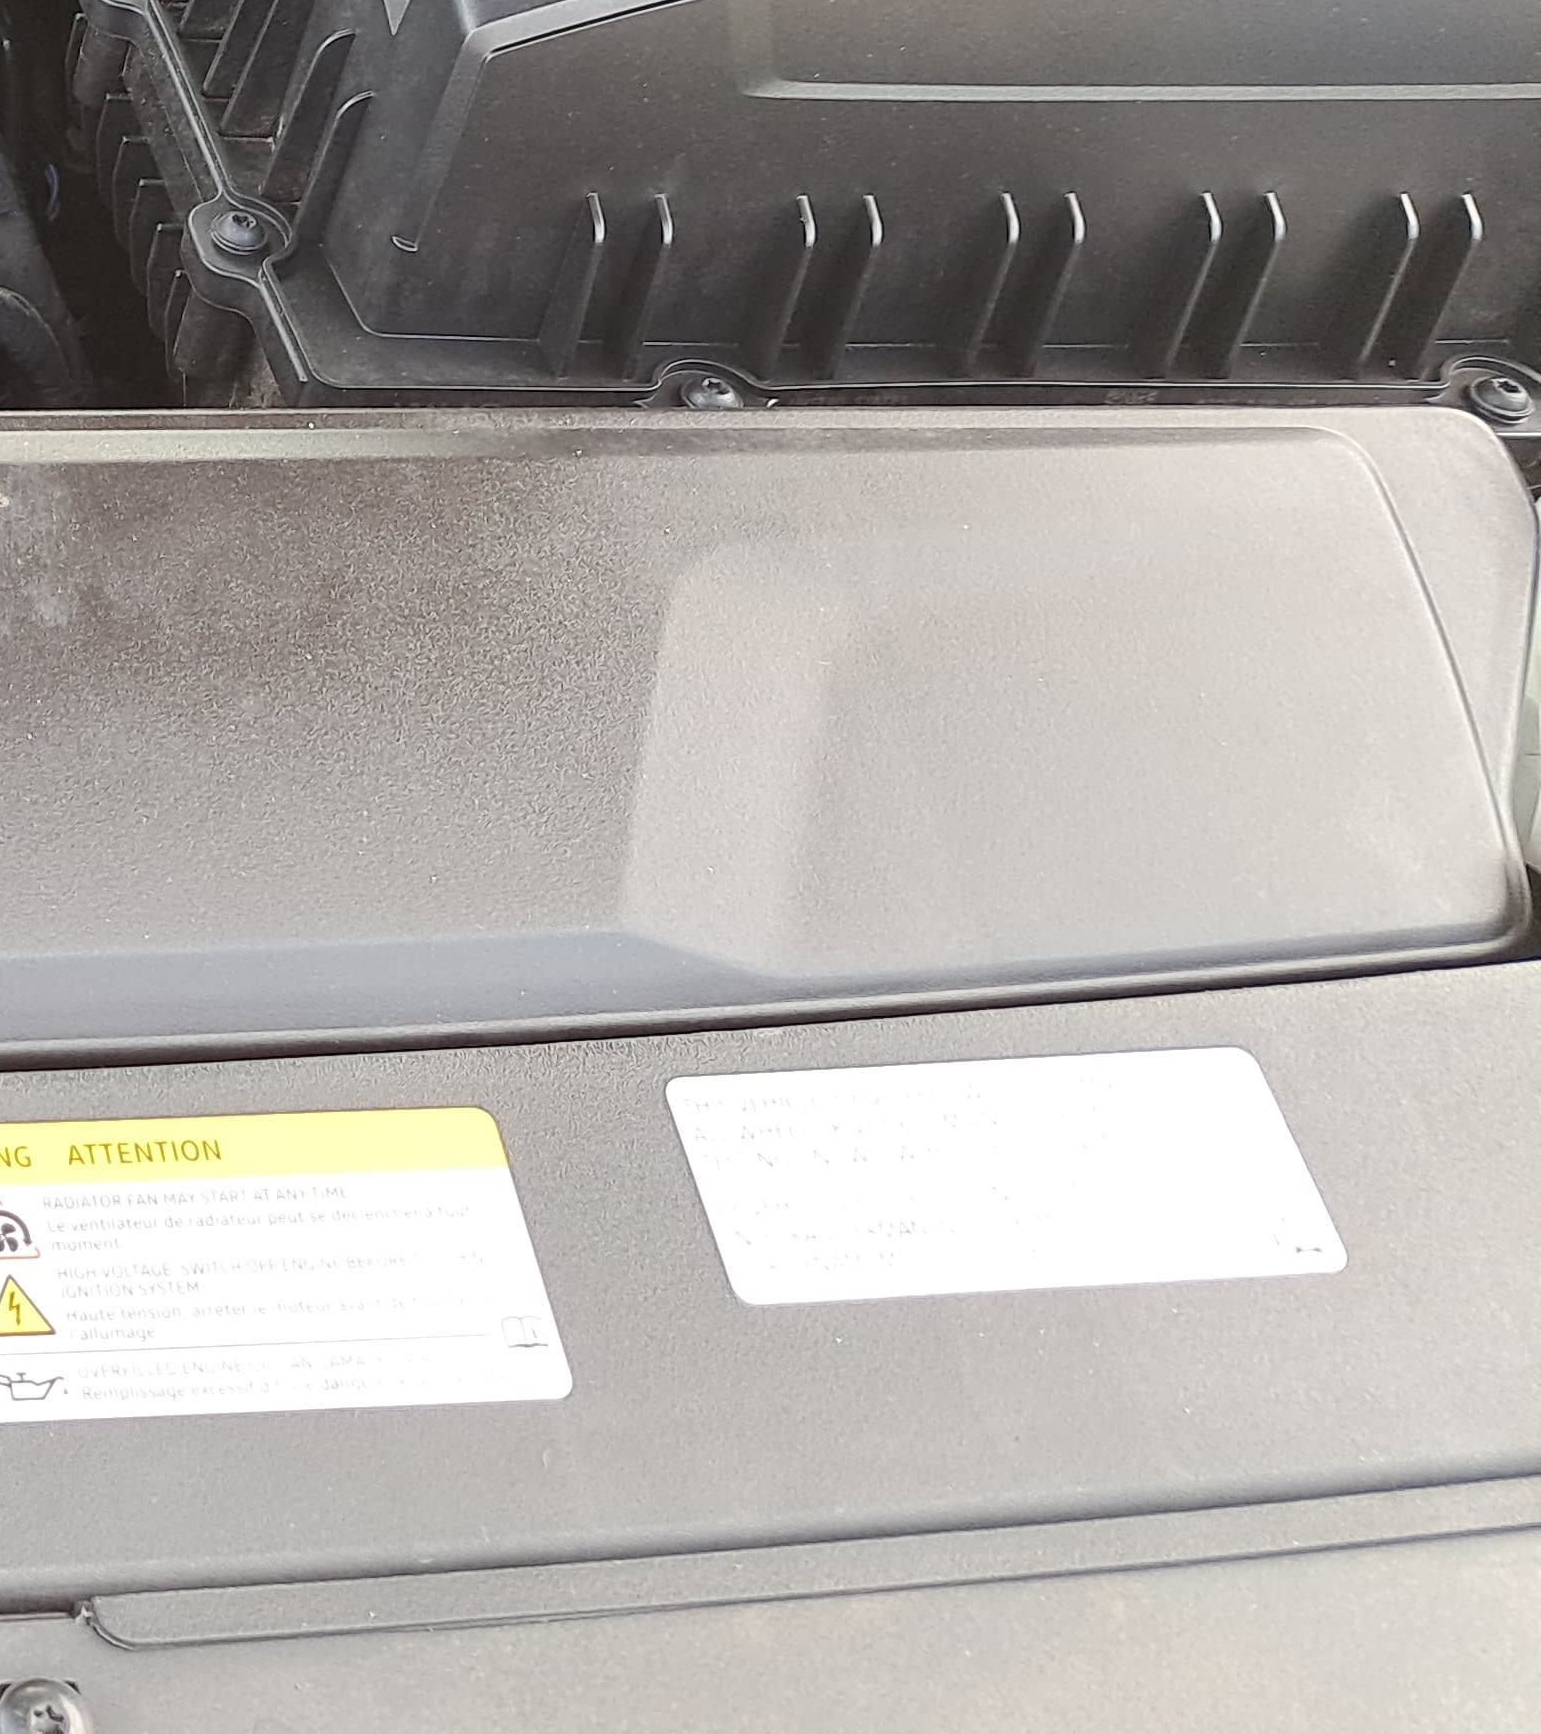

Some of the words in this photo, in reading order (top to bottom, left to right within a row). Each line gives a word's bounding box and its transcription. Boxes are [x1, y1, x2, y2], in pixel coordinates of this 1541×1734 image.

[68, 1139, 222, 1166] ATTENTION
[42, 1193, 121, 1209] RADIATOR
[126, 1192, 158, 1206] FAN
[163, 1191, 195, 1205] MAY
[200, 1188, 246, 1204] START
[253, 1188, 269, 1201] AT
[47, 1219, 66, 1233] Le
[71, 1218, 157, 1232] ventilateur
[164, 1215, 184, 1229] de
[268, 1210, 304, 1226] peut
[310, 1211, 326, 1223] se
[61, 1284, 135, 1299] IGNITION
[138, 1281, 201, 1296] SYSTEM
[66, 1308, 115, 1322] Haute
